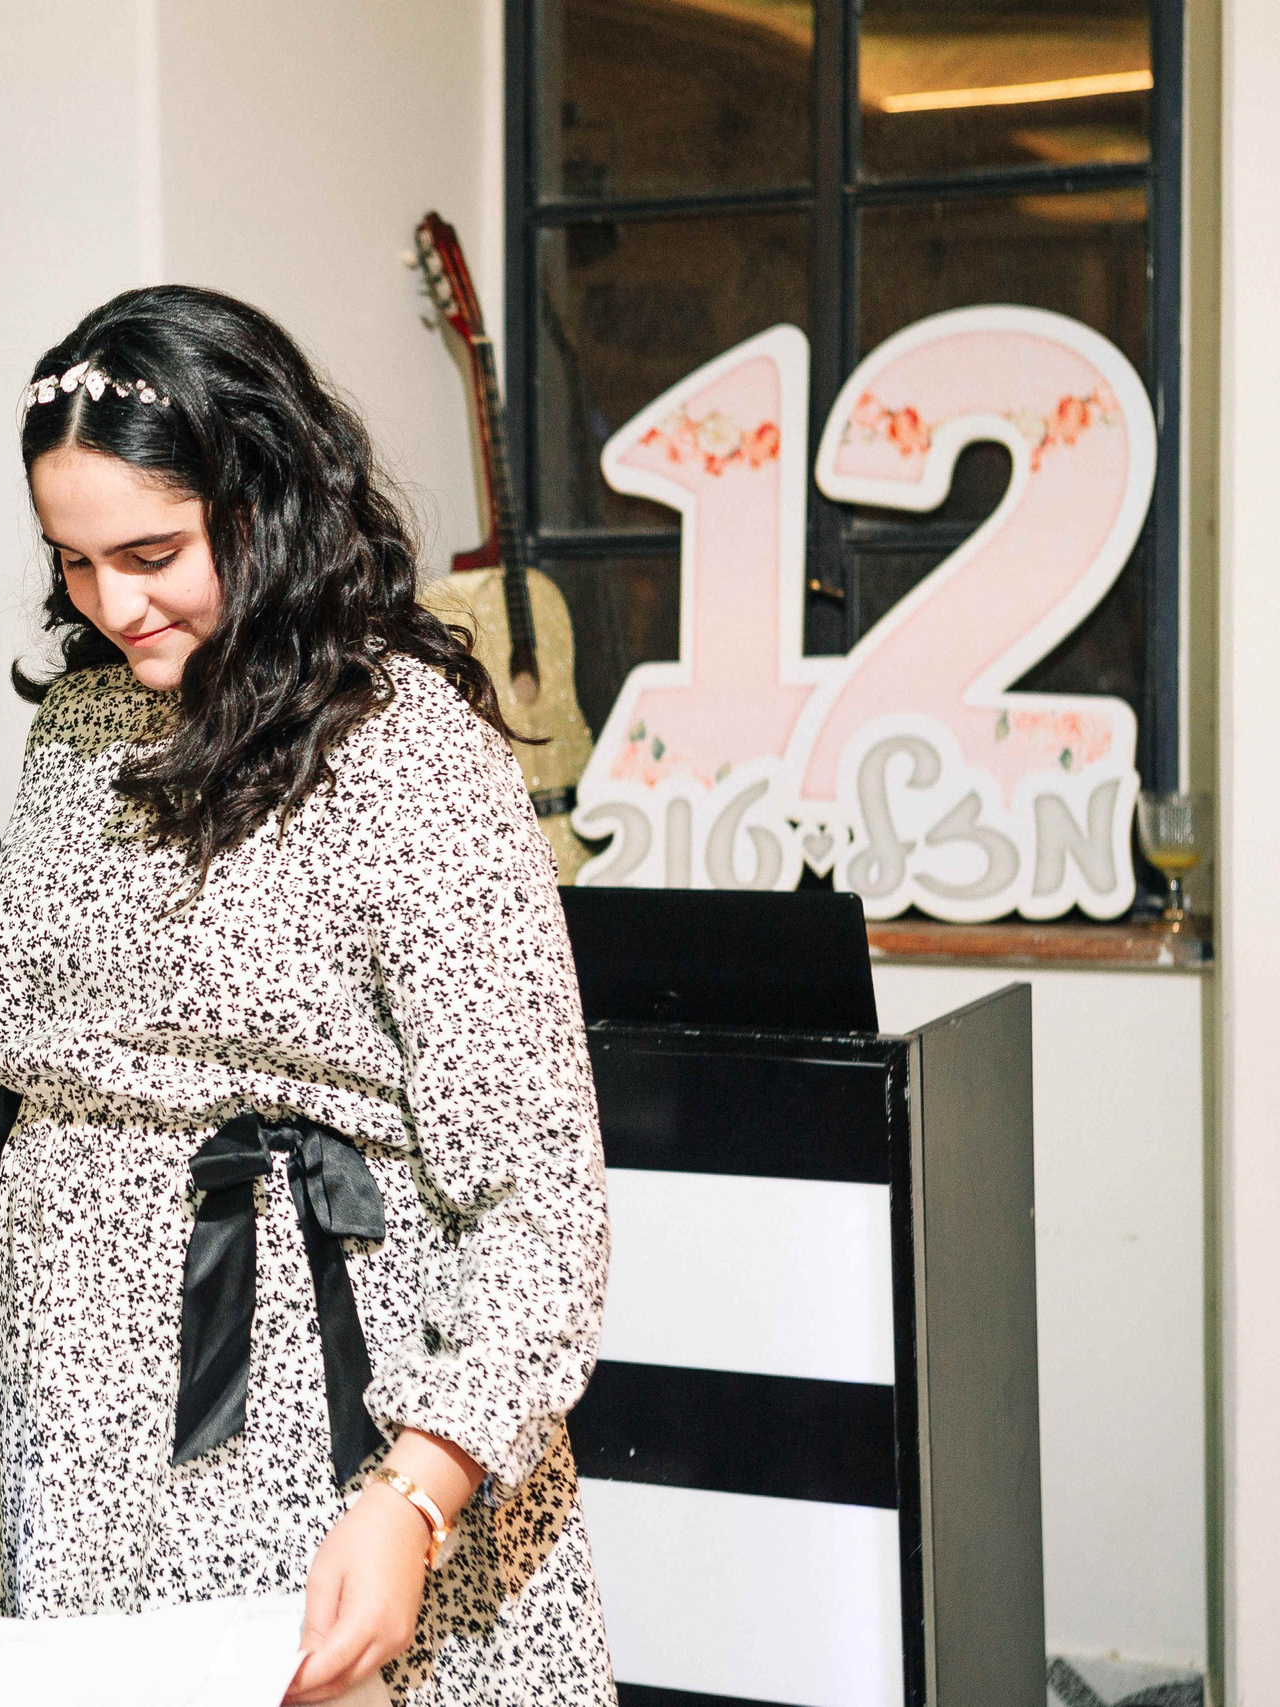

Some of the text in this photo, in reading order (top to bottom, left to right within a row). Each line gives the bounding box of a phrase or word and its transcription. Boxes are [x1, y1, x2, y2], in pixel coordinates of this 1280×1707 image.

[590, 305, 1157, 790] 12
[579, 735, 1123, 900] מזל טוב
